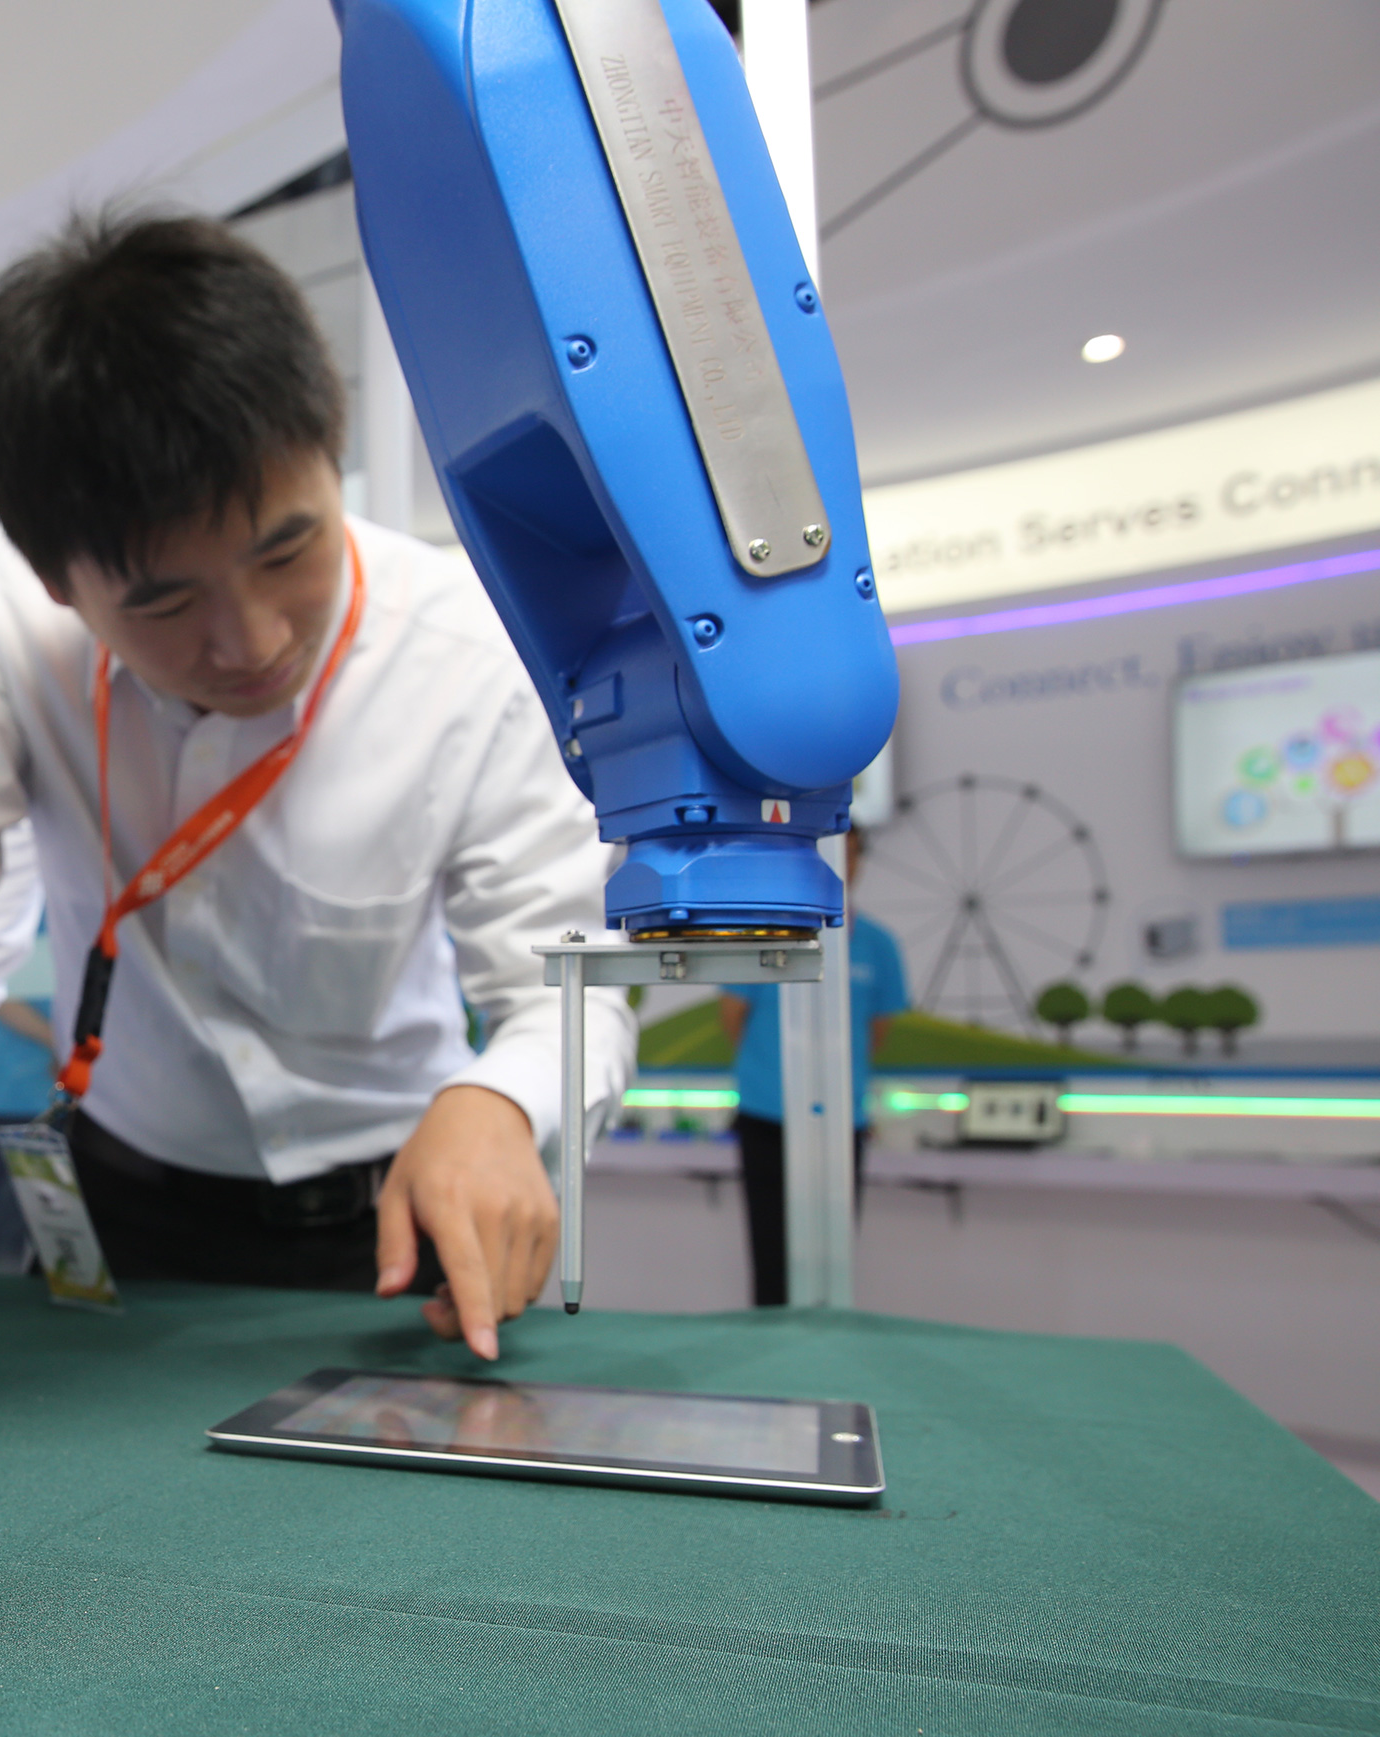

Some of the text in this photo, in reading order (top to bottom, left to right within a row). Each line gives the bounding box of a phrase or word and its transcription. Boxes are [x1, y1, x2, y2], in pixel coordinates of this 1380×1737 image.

[600, 53, 656, 162] ZHONGTIAN
[638, 169, 678, 228] SMART
[661, 239, 717, 345] EQUIPMENT
[1019, 495, 1199, 553] Serves
